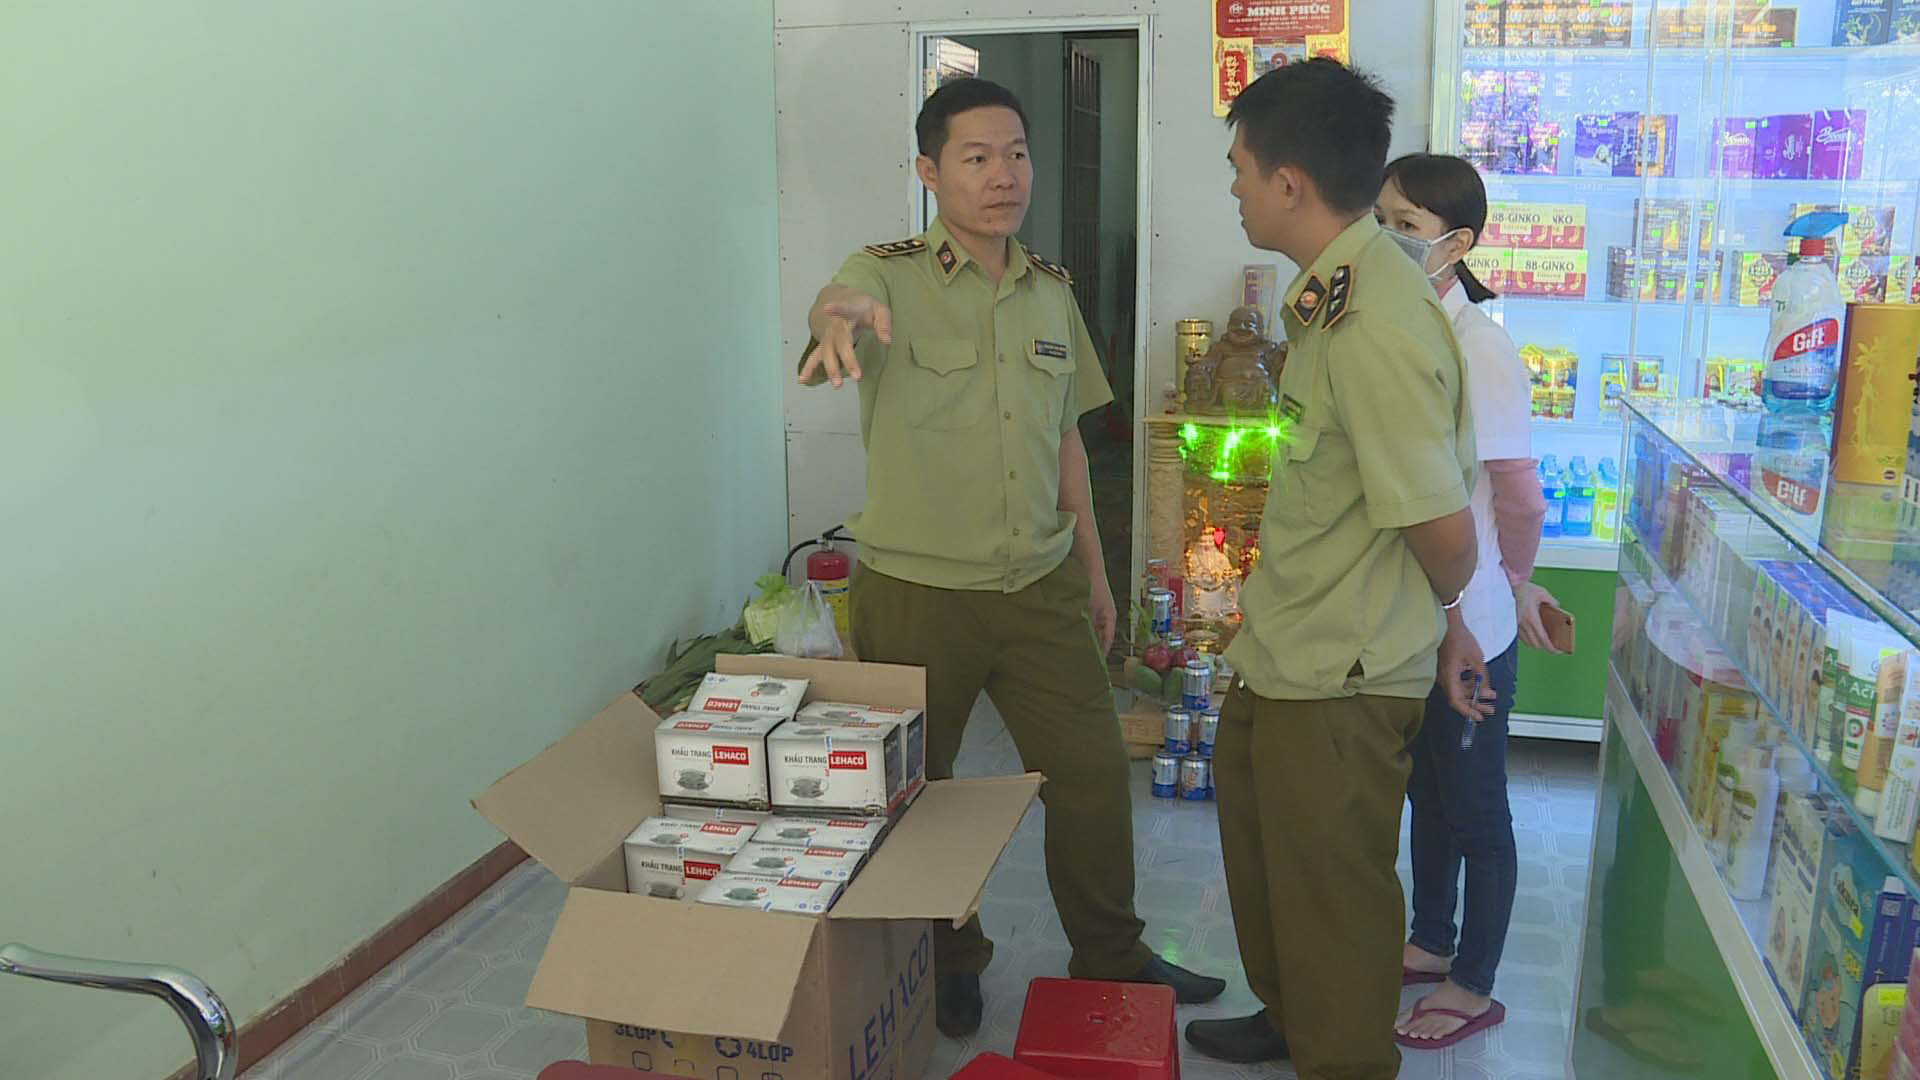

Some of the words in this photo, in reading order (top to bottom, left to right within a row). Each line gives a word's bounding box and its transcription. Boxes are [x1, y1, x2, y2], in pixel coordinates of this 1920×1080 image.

[1247, 6, 1285, 17] MINH
[1792, 327, 1825, 353] Gift
[714, 750, 746, 761] LEHACO
[805, 755, 828, 765] TRANG
[830, 756, 865, 766] LEHACO
[703, 824, 738, 834] LEHACO
